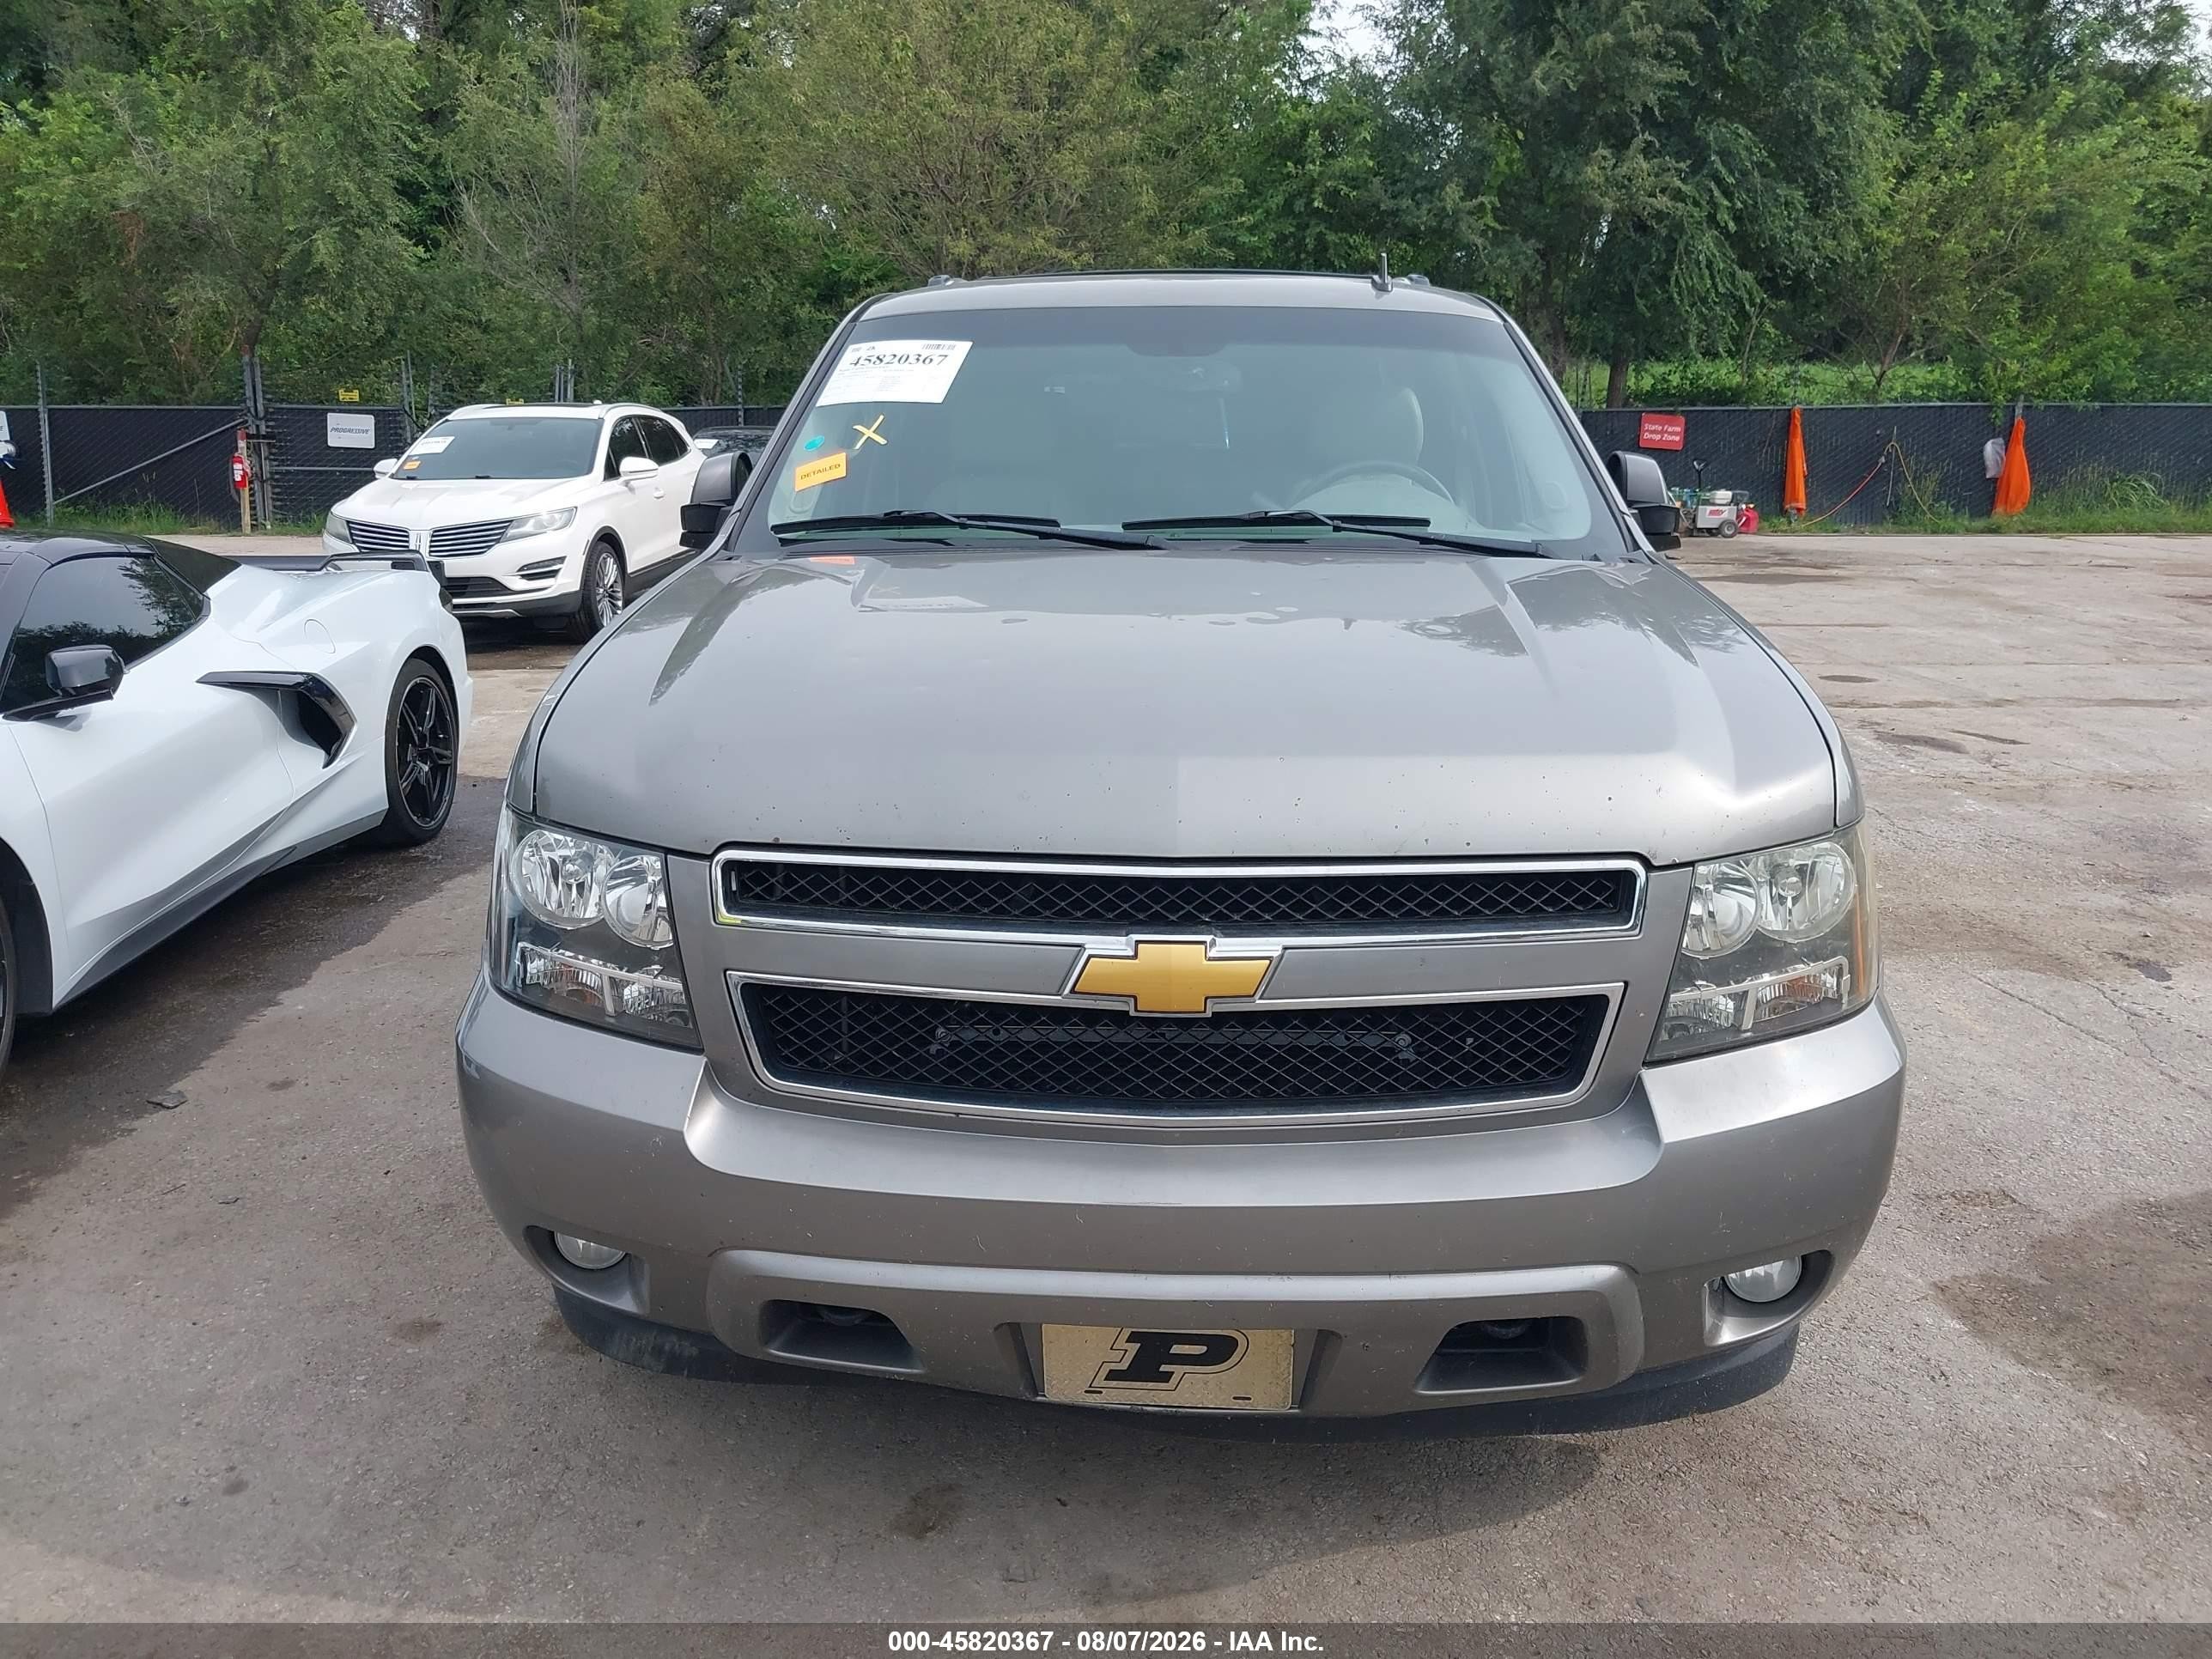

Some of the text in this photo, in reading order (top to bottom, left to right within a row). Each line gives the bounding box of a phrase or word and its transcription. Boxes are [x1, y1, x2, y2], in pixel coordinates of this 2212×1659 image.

[849, 353, 949, 368] 45820367
[330, 426, 370, 434] PROGRESSIVE
[1643, 432, 1680, 441] Drop Zone
[799, 462, 842, 480] DETAILED
[1100, 1329, 1242, 1385] P
